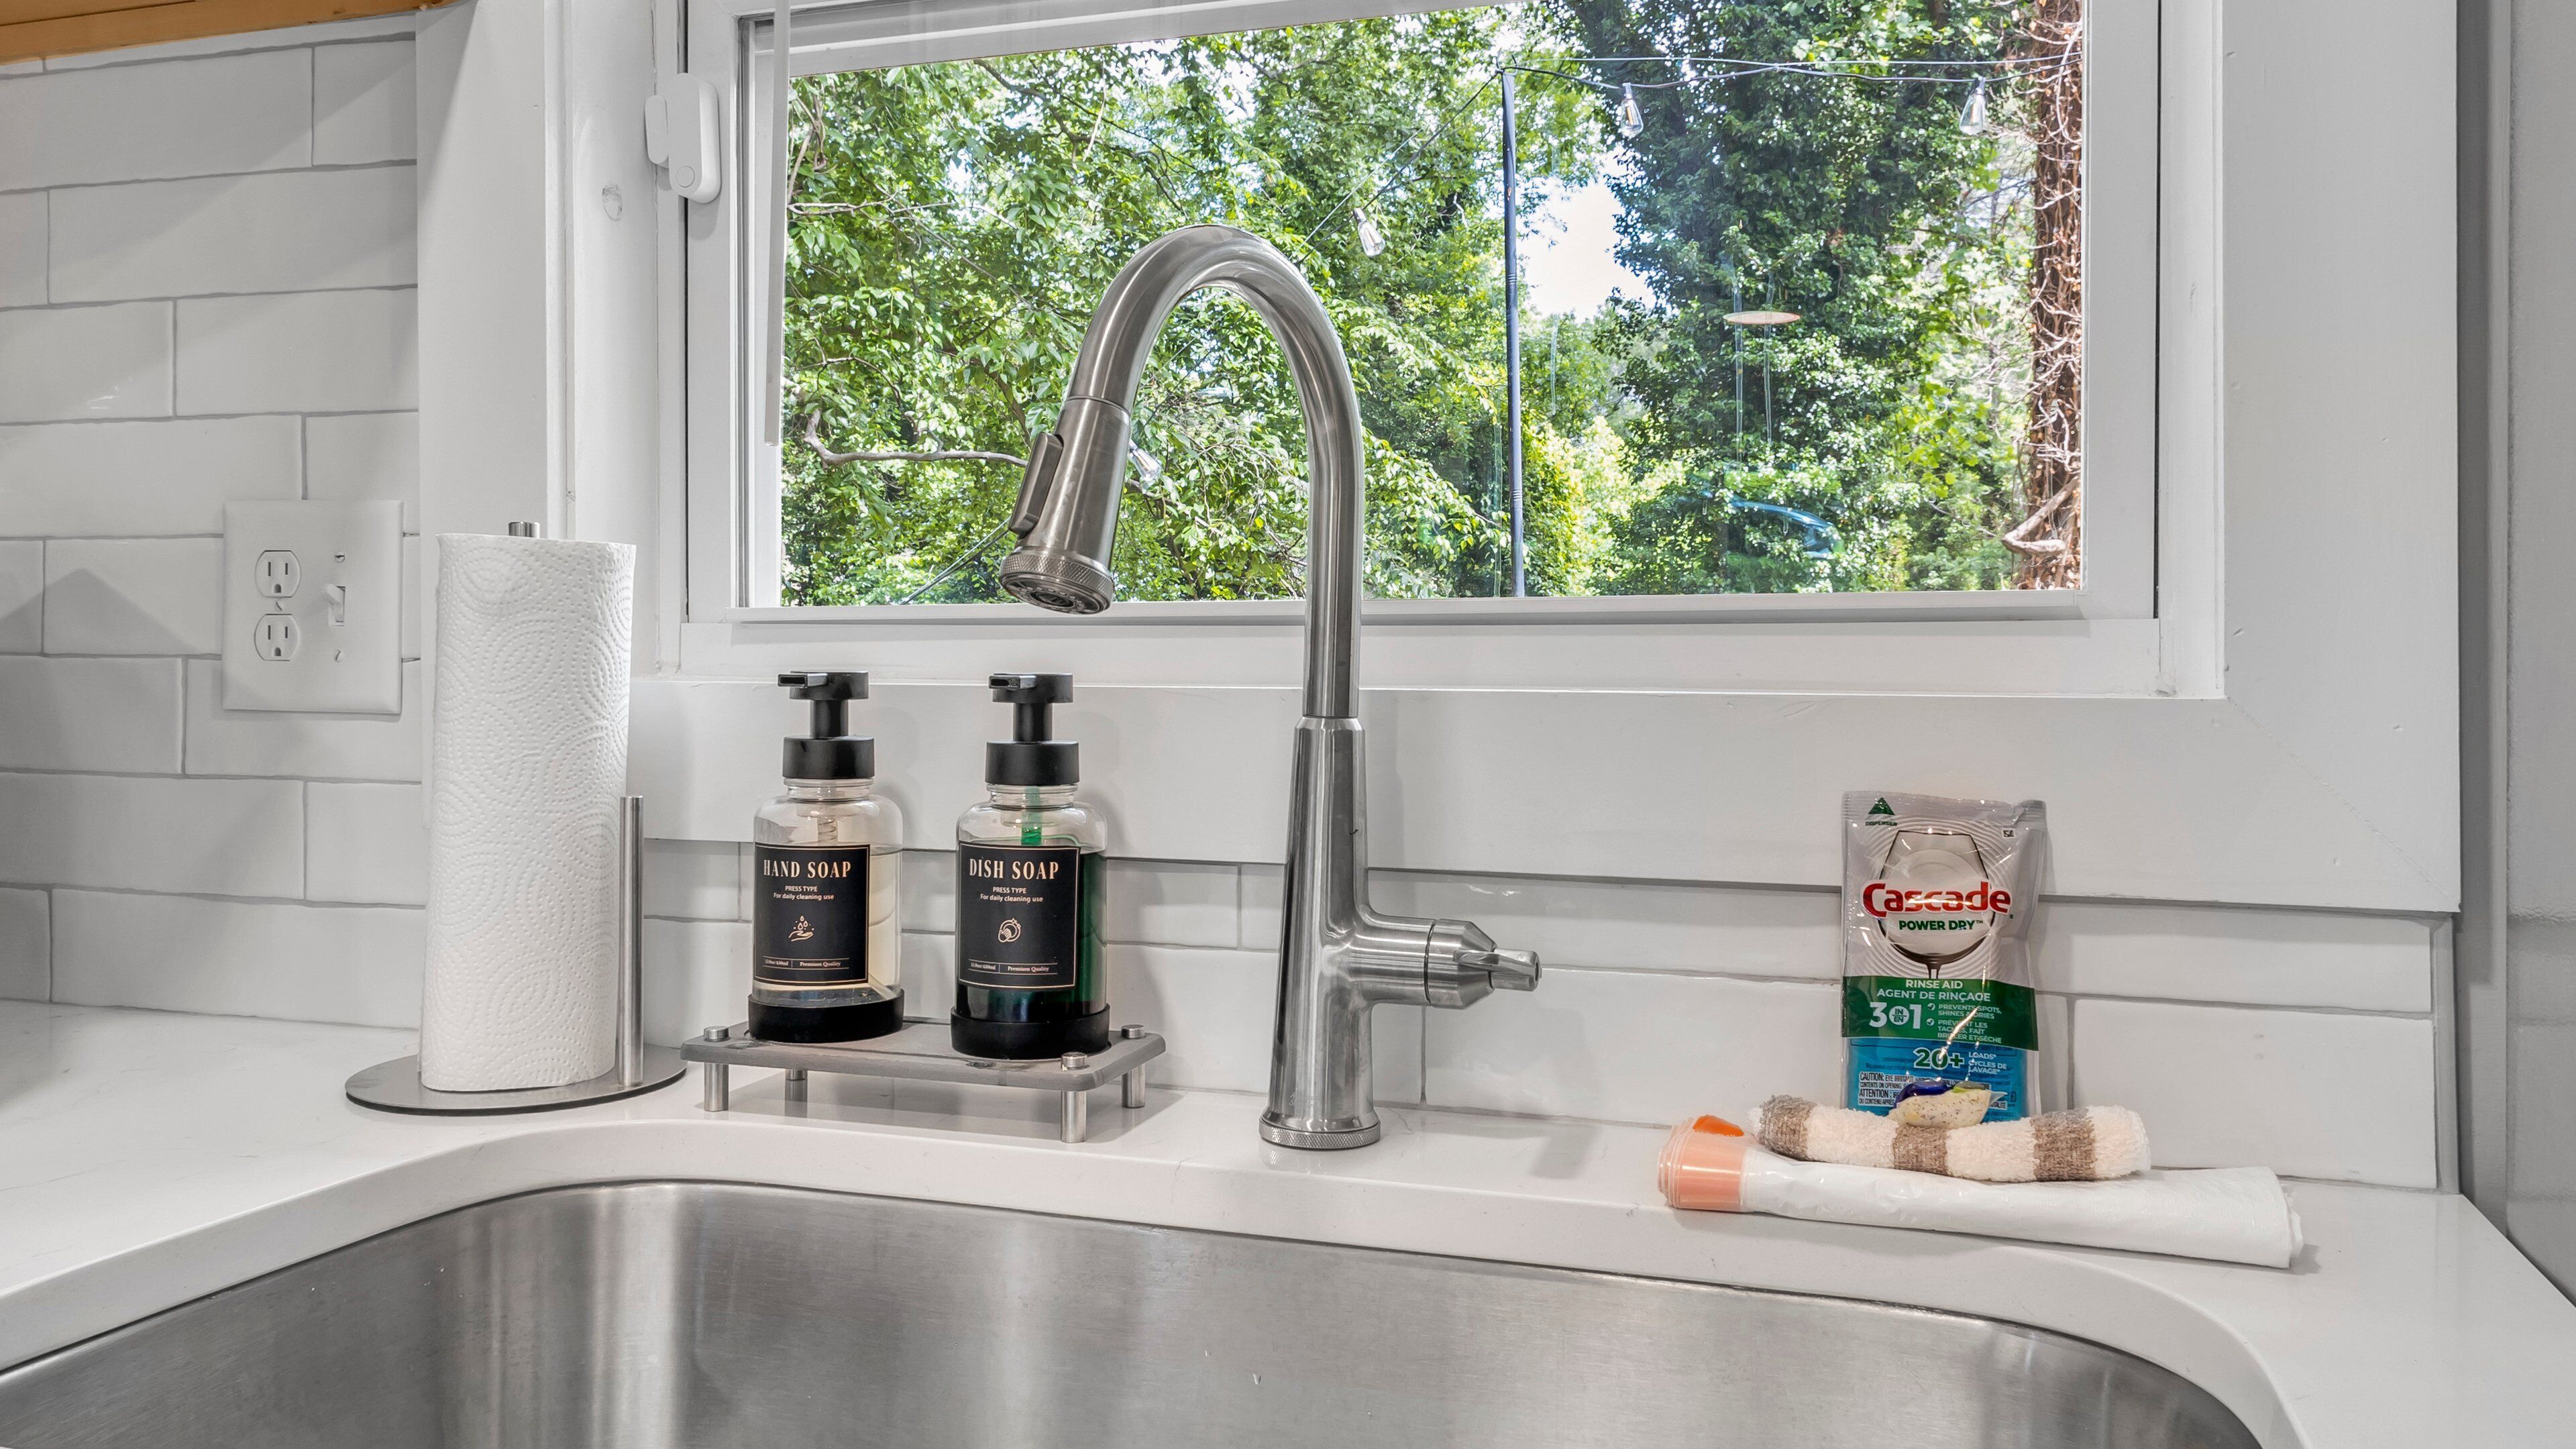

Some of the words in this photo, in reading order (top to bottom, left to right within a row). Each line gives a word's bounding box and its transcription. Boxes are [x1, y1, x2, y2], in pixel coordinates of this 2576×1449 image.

[763, 859, 800, 878] HAND
[807, 861, 851, 879] SOAP
[969, 858, 1004, 879] DISH
[1012, 861, 1059, 880] SOAP
[782, 892, 795, 900] daily
[989, 894, 1004, 902] daily
[1004, 895, 1031, 904] cleaning
[1862, 881, 2011, 918] Cascade
[1898, 920, 1945, 930] POWER
[1905, 979, 1940, 989] RINSE
[1941, 980, 1963, 989] AID
[1876, 988, 1917, 999] AGENT
[1919, 991, 1935, 1000] DE
[1938, 991, 1991, 1003] RINÇAGE
[1869, 1002, 1888, 1028] 3
[1909, 1004, 1922, 1029] 1
[1938, 1018, 1973, 1026] PRÉVNT
[1913, 1047, 1965, 1070] 20+
[1860, 1073, 1884, 1081] CAUTION:
[1860, 1089, 1889, 1097] ATTENTION
